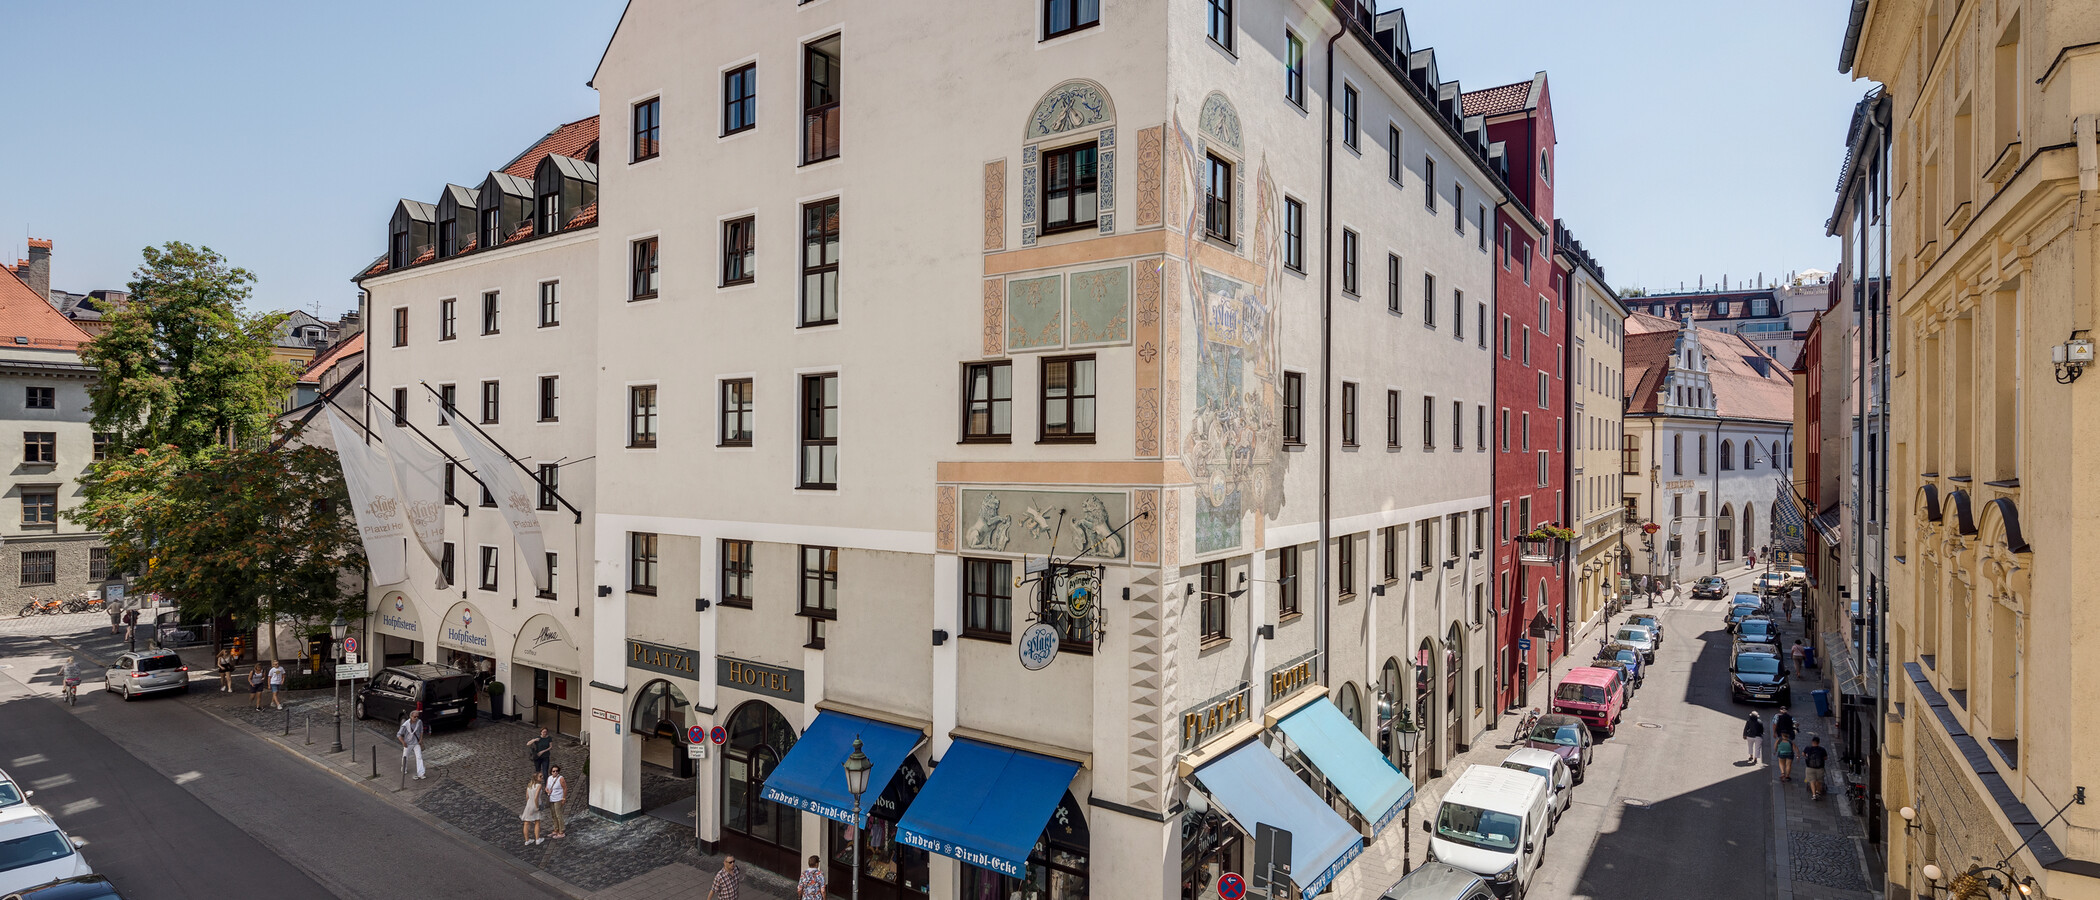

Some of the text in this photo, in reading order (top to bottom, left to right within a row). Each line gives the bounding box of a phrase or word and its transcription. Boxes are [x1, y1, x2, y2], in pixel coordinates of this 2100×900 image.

[364, 523, 390, 534] Platzl
[1069, 577, 1091, 589] Ayinger
[383, 615, 417, 631] Hofpfisterei
[448, 628, 487, 646] Hofpfisterei
[633, 643, 792, 692] PLATZL HOTEL
[1185, 661, 1312, 741] PLATZL HOTEL
[768, 788, 861, 825] Indra's Dirndl-Eck
[904, 831, 1017, 875] Indra's Dirndl-Ecke
